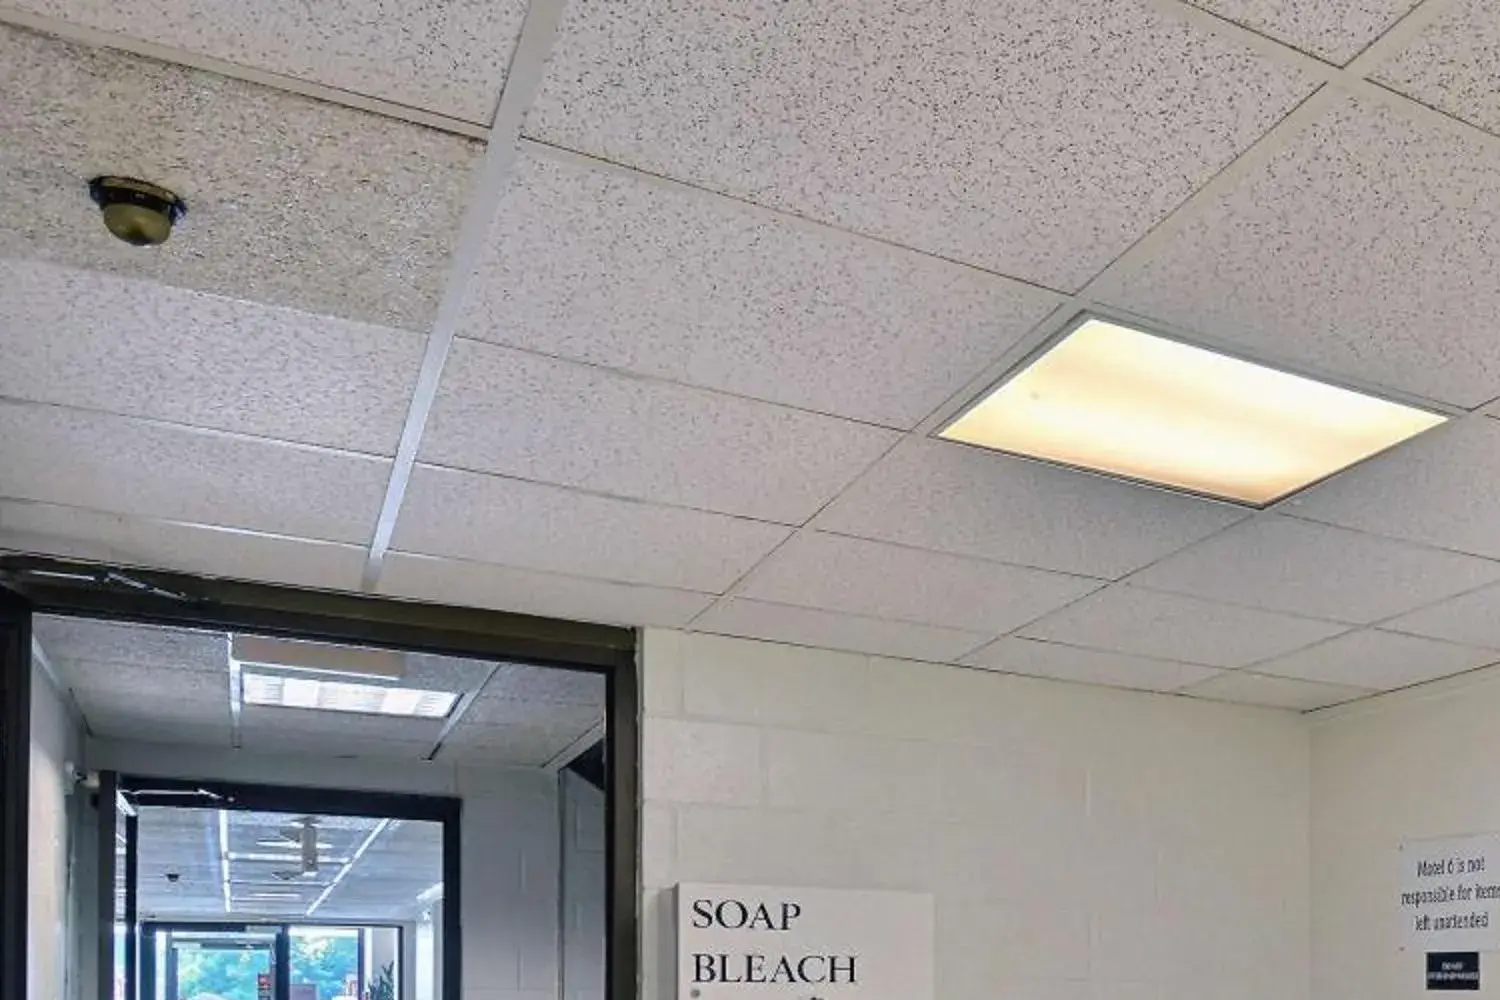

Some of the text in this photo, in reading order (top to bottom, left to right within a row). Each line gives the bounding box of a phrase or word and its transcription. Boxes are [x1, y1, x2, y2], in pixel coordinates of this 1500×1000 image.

[1416, 859, 1445, 878] Motel
[1468, 856, 1486, 873] not
[1401, 885, 1455, 908] responsible
[1457, 884, 1473, 901] for
[691, 899, 802, 931] SOAP
[1415, 913, 1431, 931] left
[691, 952, 859, 984] BLEACH
